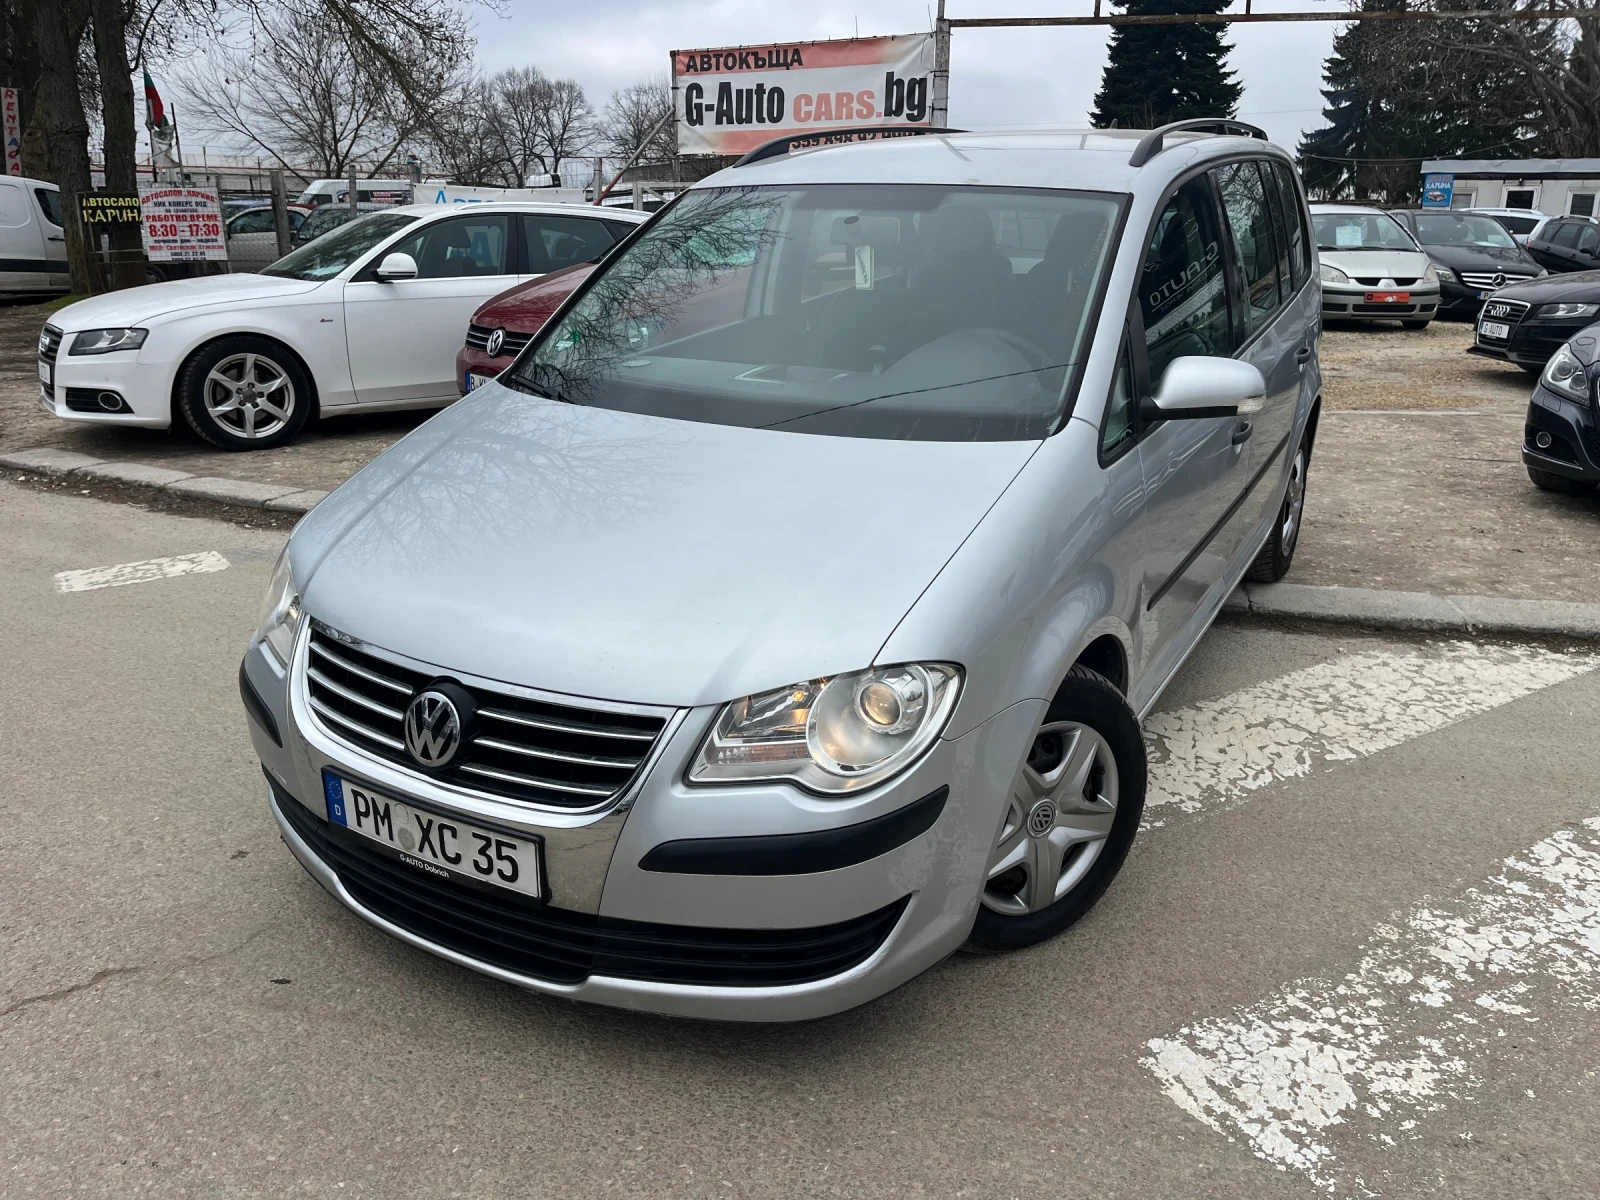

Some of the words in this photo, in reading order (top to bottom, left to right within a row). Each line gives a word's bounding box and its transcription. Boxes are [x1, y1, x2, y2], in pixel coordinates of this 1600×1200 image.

[686, 48, 803, 73] АВТОКЪЩА
[4, 89, 17, 136] RENT
[685, 81, 785, 126] G-Auto
[8, 150, 20, 177] CA
[82, 197, 140, 207] АВТОСАЛО
[142, 189, 183, 205] АВТОСАЛОН
[145, 214, 188, 223] РАБОТНО
[190, 213, 219, 222] ВРЕМЕ
[149, 224, 178, 237] 8:30
[187, 223, 220, 237] 17:30
[334, 804, 341, 816] D
[351, 788, 394, 842] PM
[415, 813, 462, 865] XC
[472, 831, 519, 884] 35
[400, 853, 424, 870] G-AUTO
[424, 863, 450, 879] Dobrich
